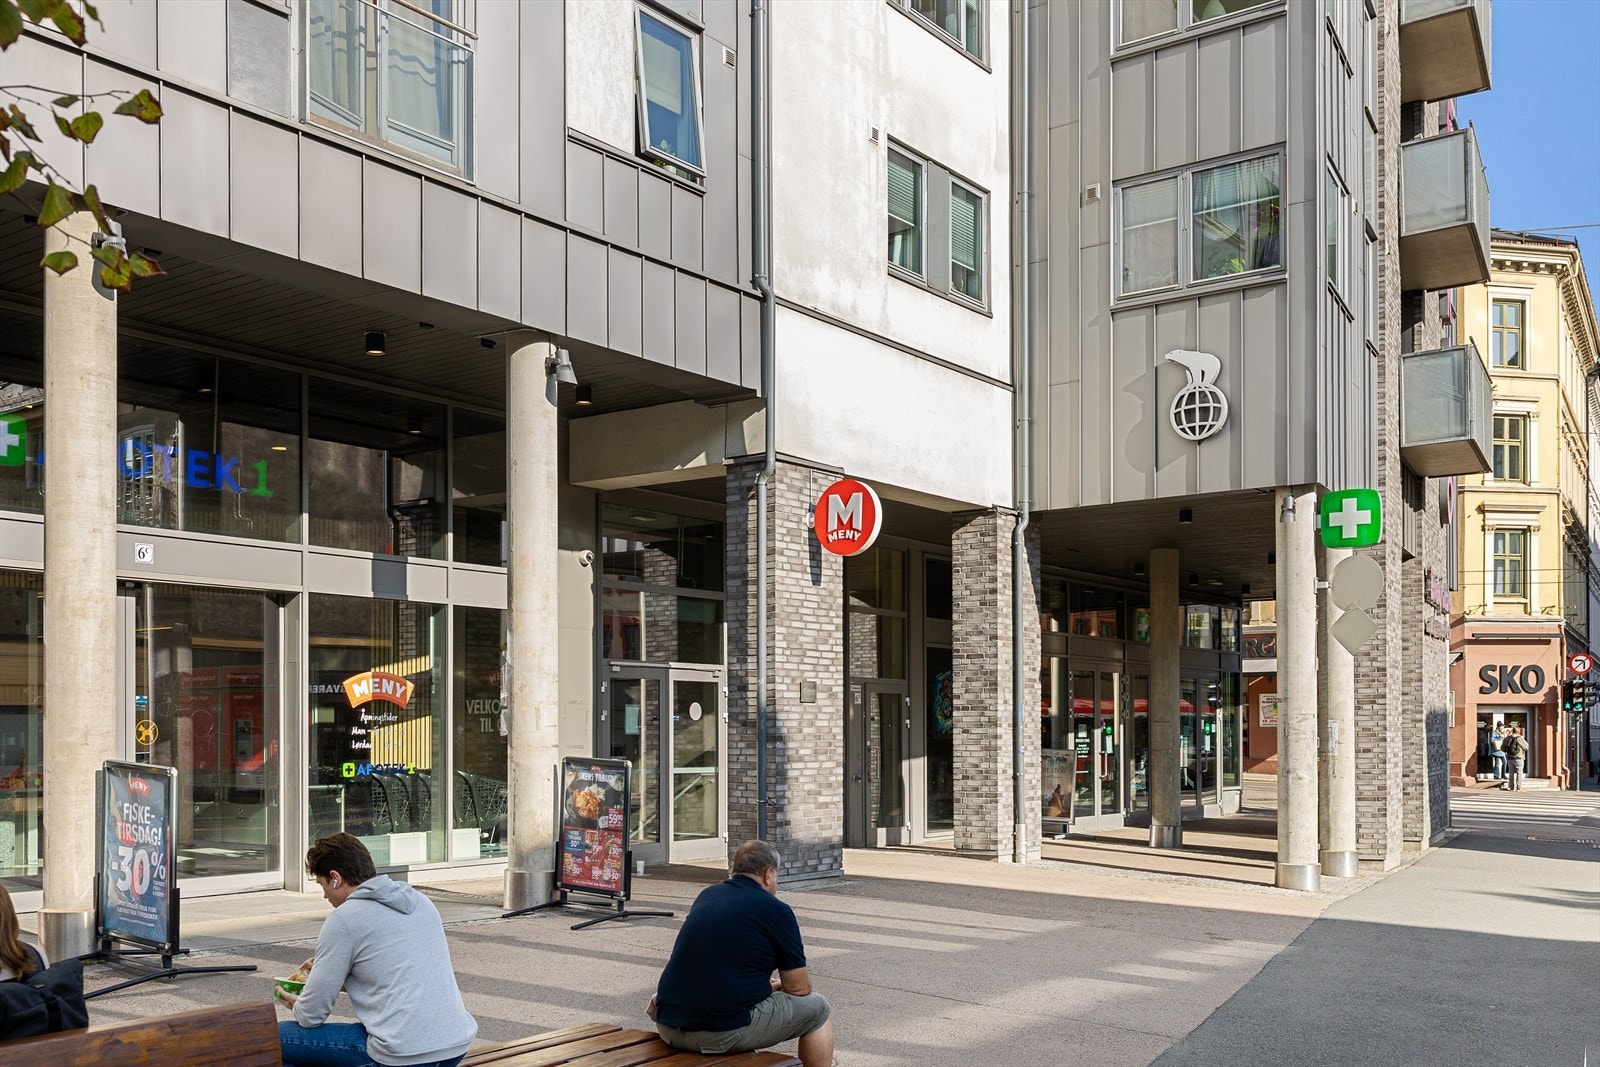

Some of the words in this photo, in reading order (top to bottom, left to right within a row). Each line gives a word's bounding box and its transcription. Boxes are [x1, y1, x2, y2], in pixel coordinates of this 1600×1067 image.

[827, 492, 863, 532] M
[827, 529, 862, 543] MENY
[1478, 664, 1546, 695] SKO
[352, 678, 407, 699] MENY
[360, 708, 398, 724] Åpningstider
[351, 726, 366, 735] Man
[479, 717, 494, 732] TIL
[356, 763, 406, 776] APOTEK
[408, 762, 415, 774] 1
[130, 780, 149, 791] MENY
[123, 802, 155, 825] FISKE-
[117, 822, 162, 846] TIRSDAG!
